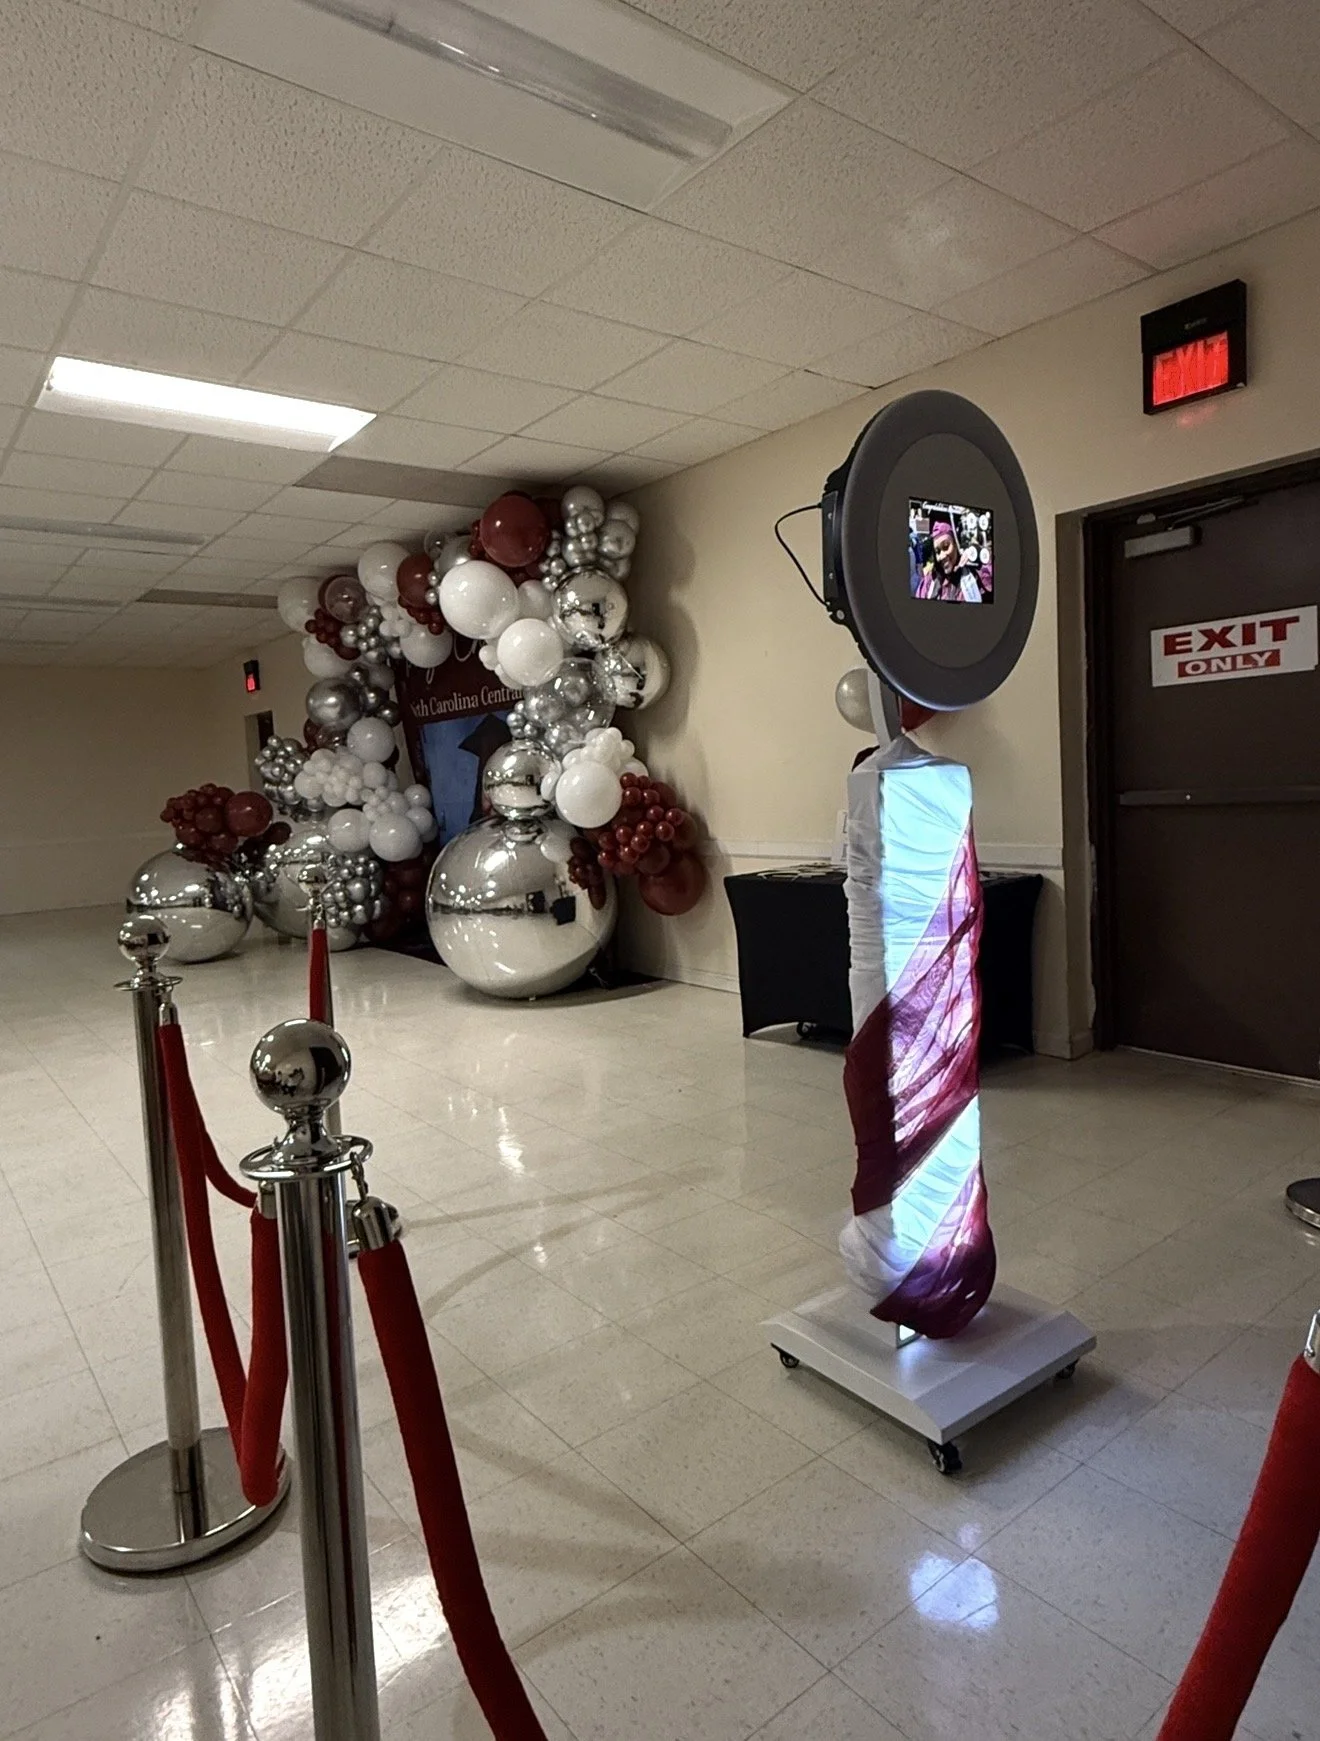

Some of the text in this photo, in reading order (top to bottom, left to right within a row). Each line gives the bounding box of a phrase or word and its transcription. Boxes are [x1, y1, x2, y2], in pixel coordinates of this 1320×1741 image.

[1163, 616, 1300, 656] EXIT
[1185, 651, 1272, 675] ONLY
[429, 692, 479, 716] Carolina
